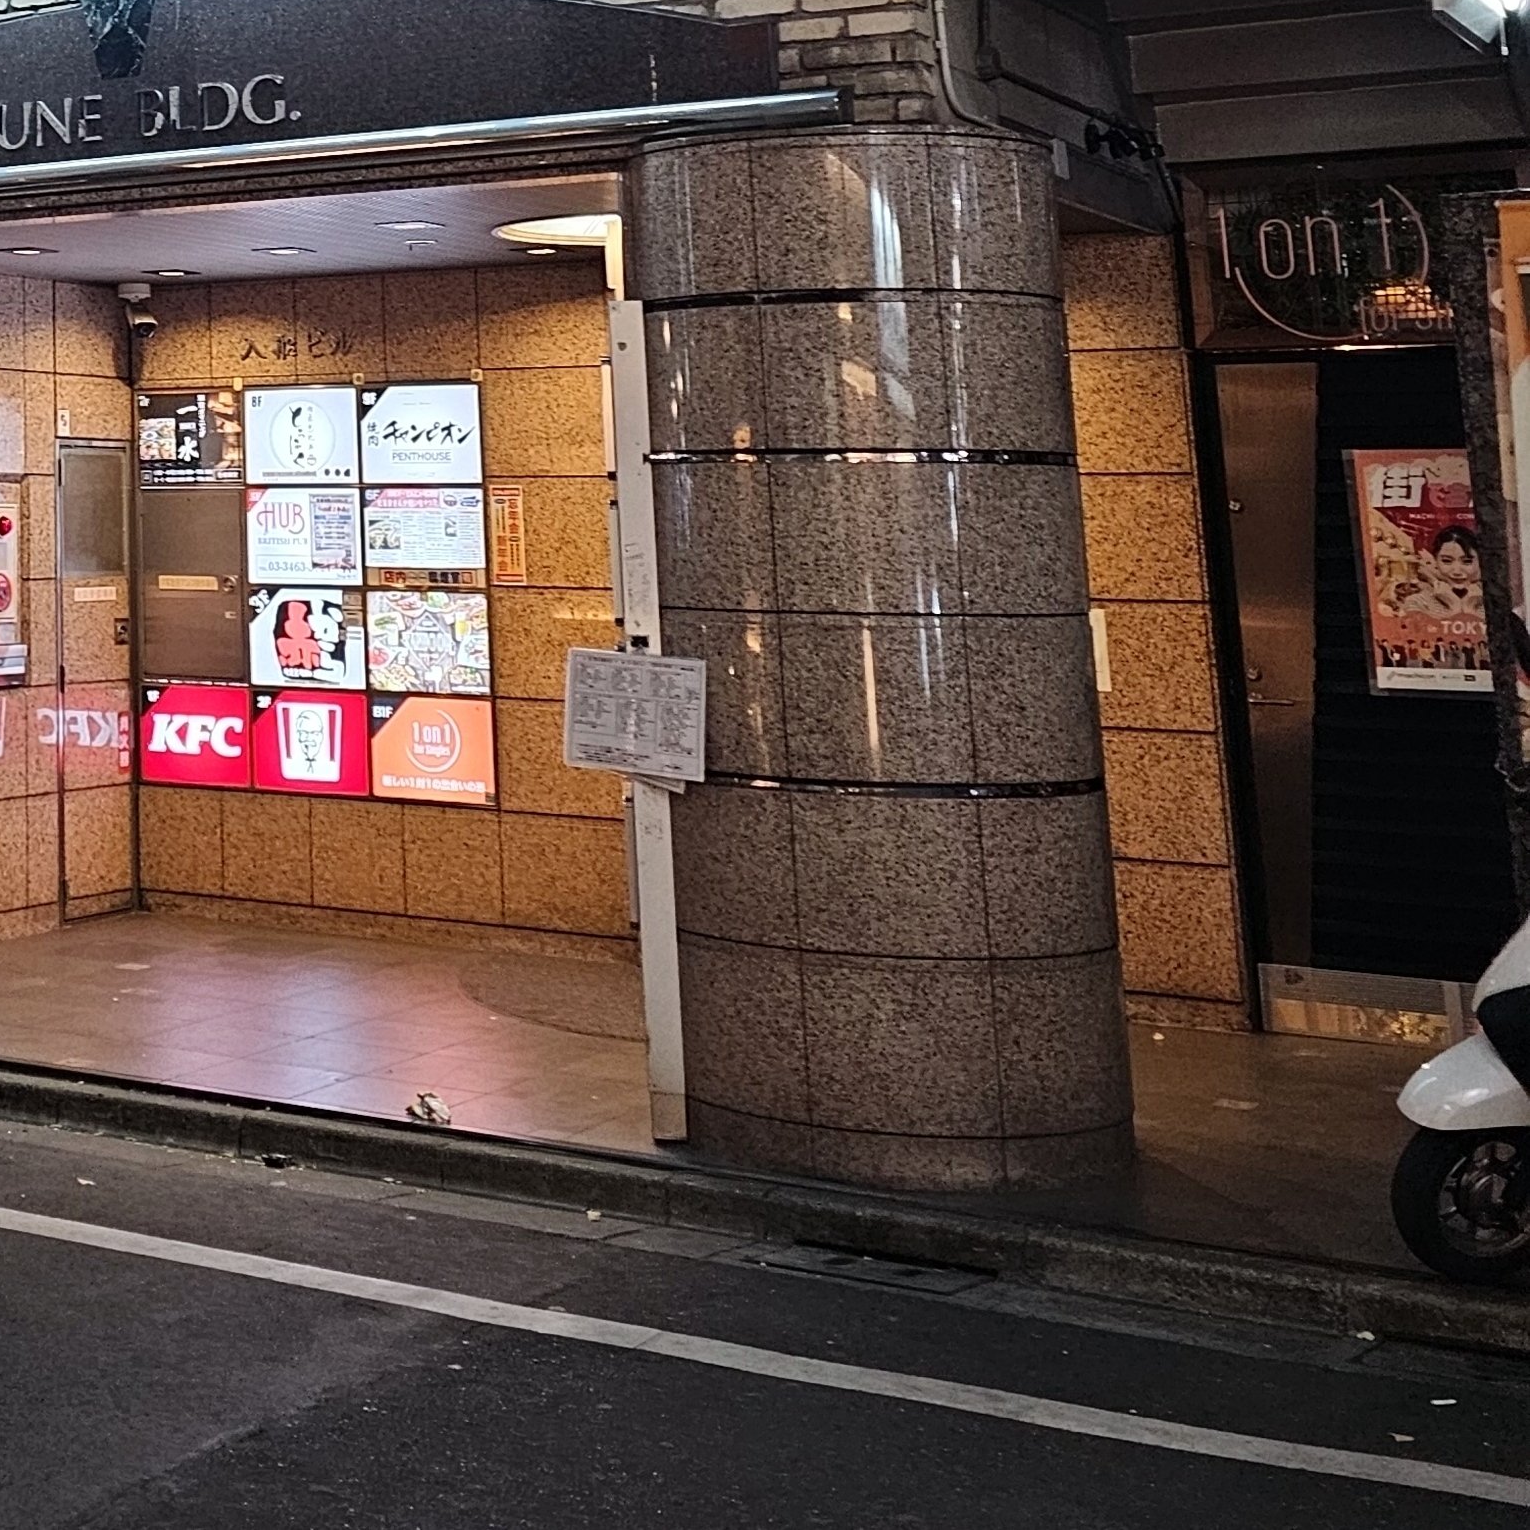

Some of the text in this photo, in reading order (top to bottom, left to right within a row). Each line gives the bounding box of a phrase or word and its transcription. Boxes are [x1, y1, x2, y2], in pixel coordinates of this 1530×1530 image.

[135, 73, 302, 138] BLDG.
[1210, 205, 1232, 279] 1
[1258, 215, 1343, 281] on
[382, 419, 476, 445] チャンピオン
[391, 451, 452, 462] PENTHOUSE
[256, 501, 305, 536] HUB
[372, 705, 394, 719] B1F
[147, 712, 245, 759] KFC
